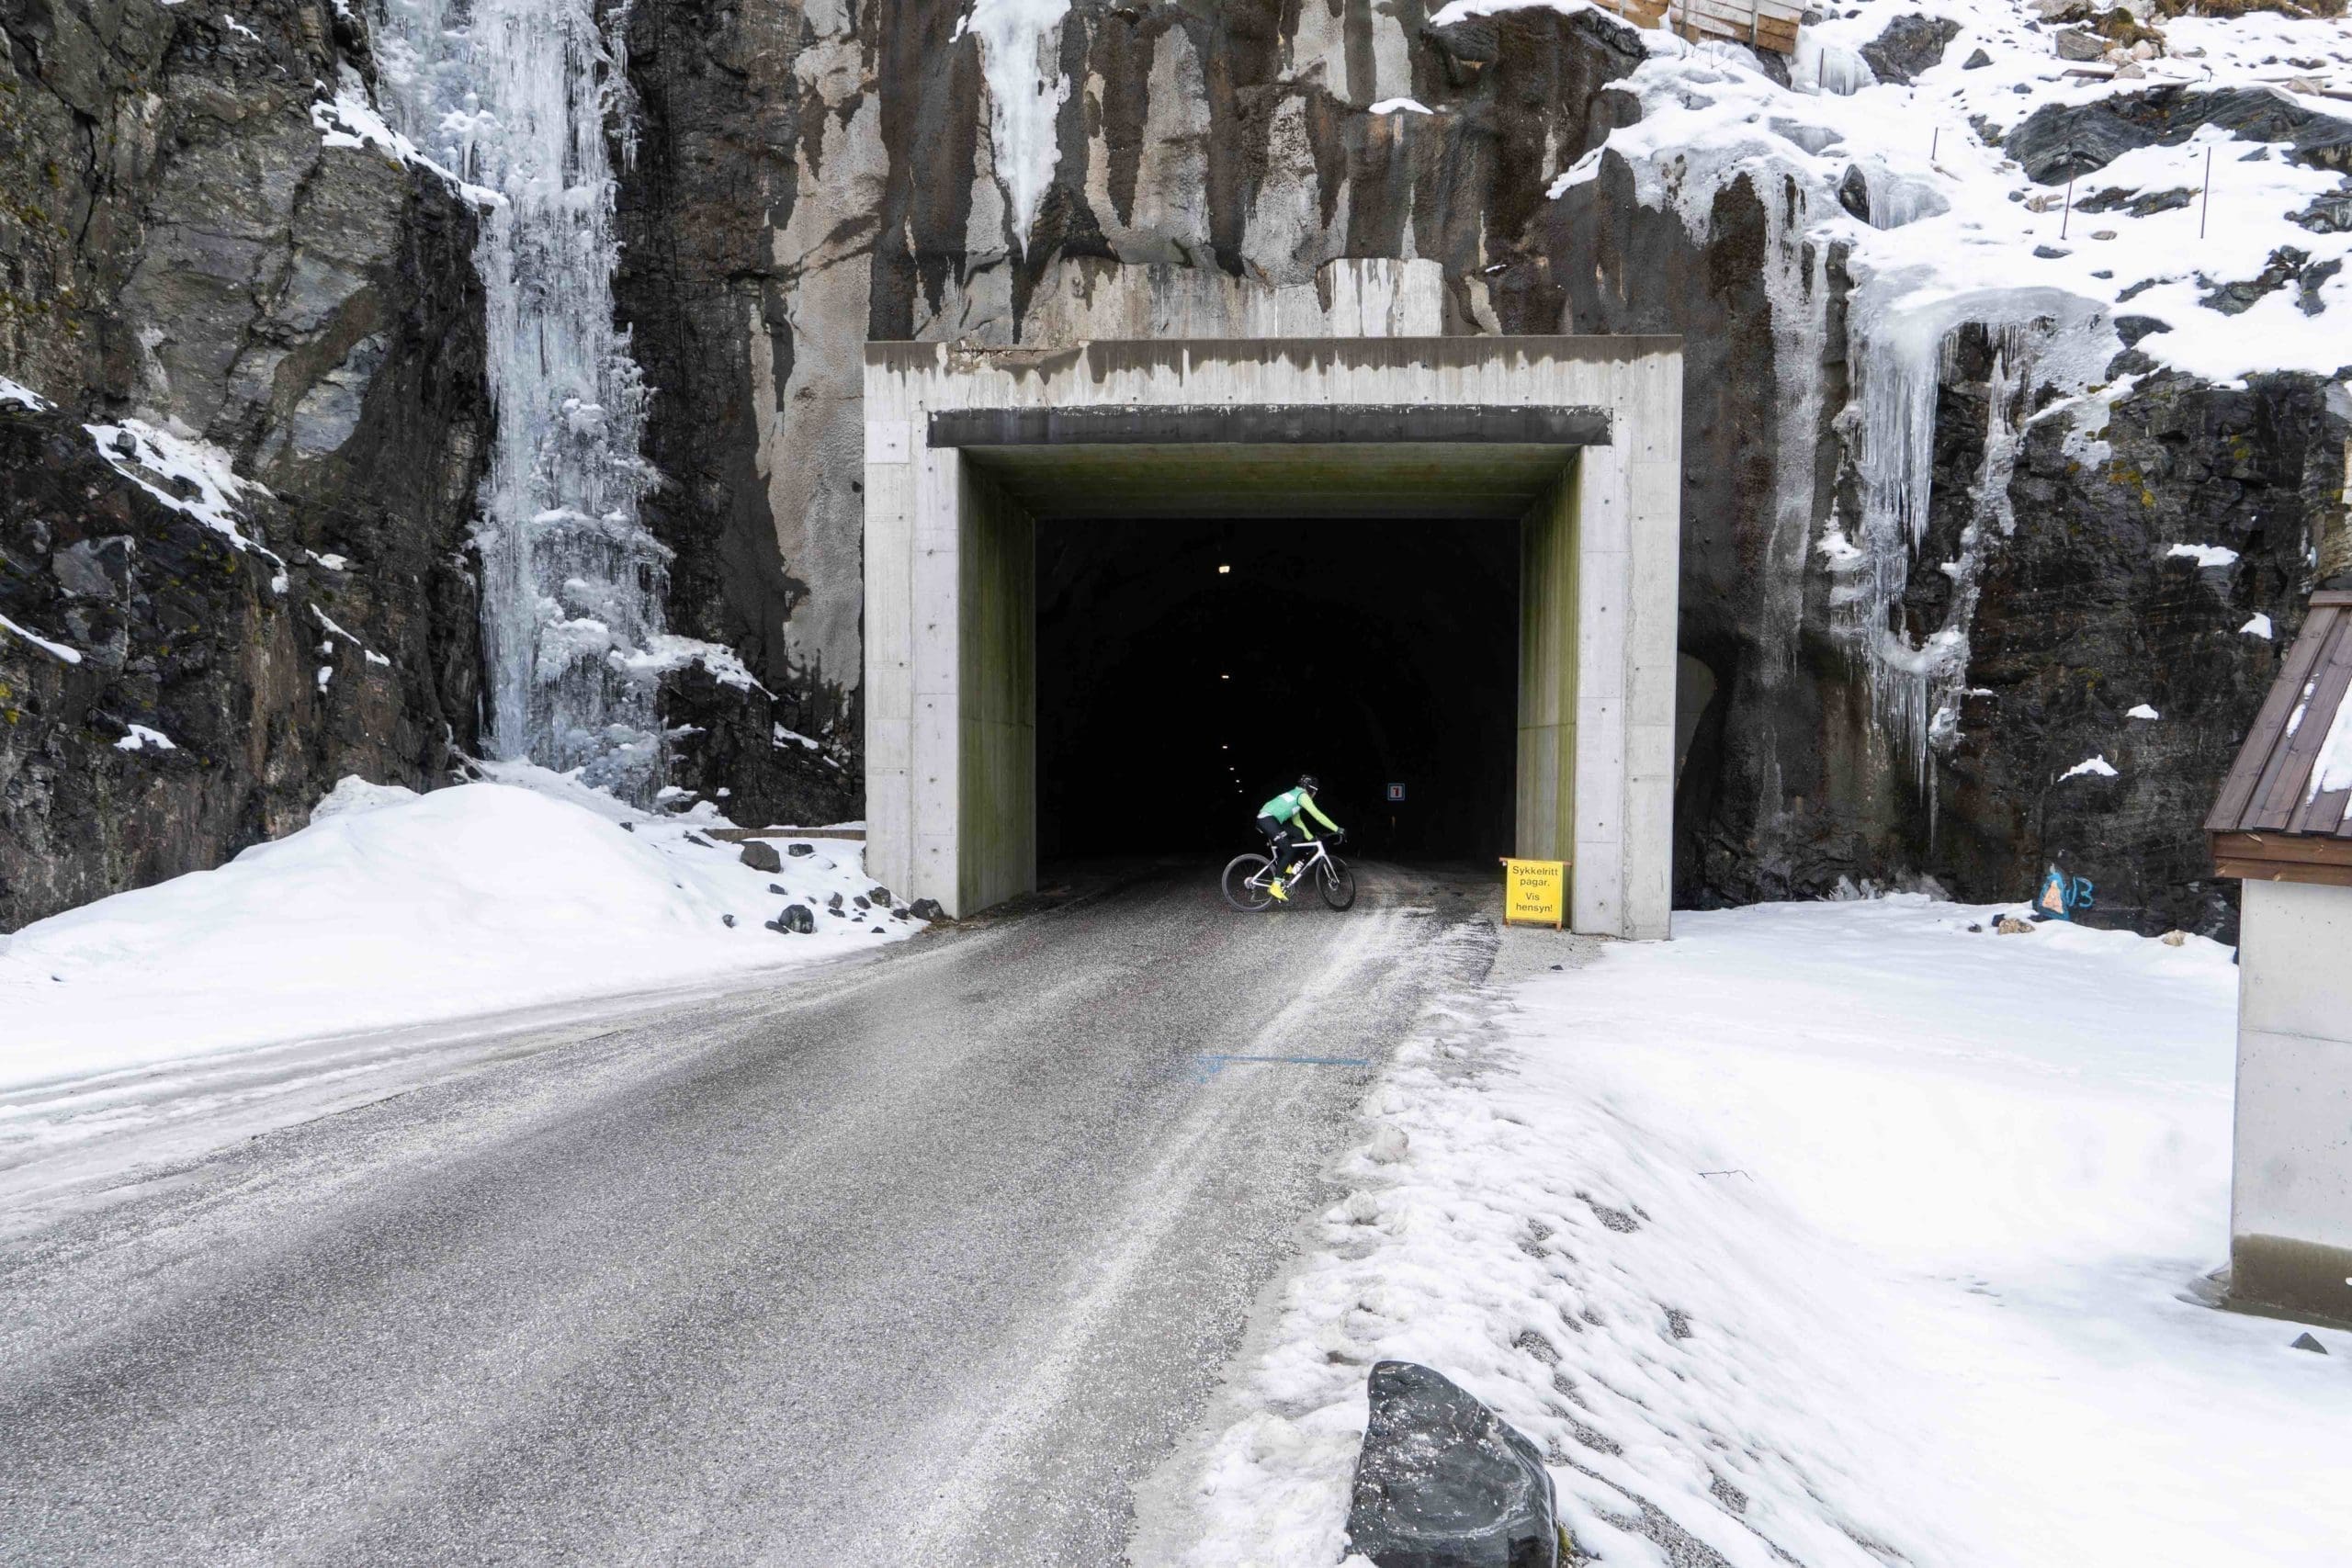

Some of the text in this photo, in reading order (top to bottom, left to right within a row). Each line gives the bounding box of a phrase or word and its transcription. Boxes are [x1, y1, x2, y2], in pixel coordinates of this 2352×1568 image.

[1512, 865, 1558, 876] Sykkelritt
[1520, 878, 1550, 887] pagar.
[1525, 892, 1540, 901] Vis
[1516, 902, 1553, 913] hensyn!
